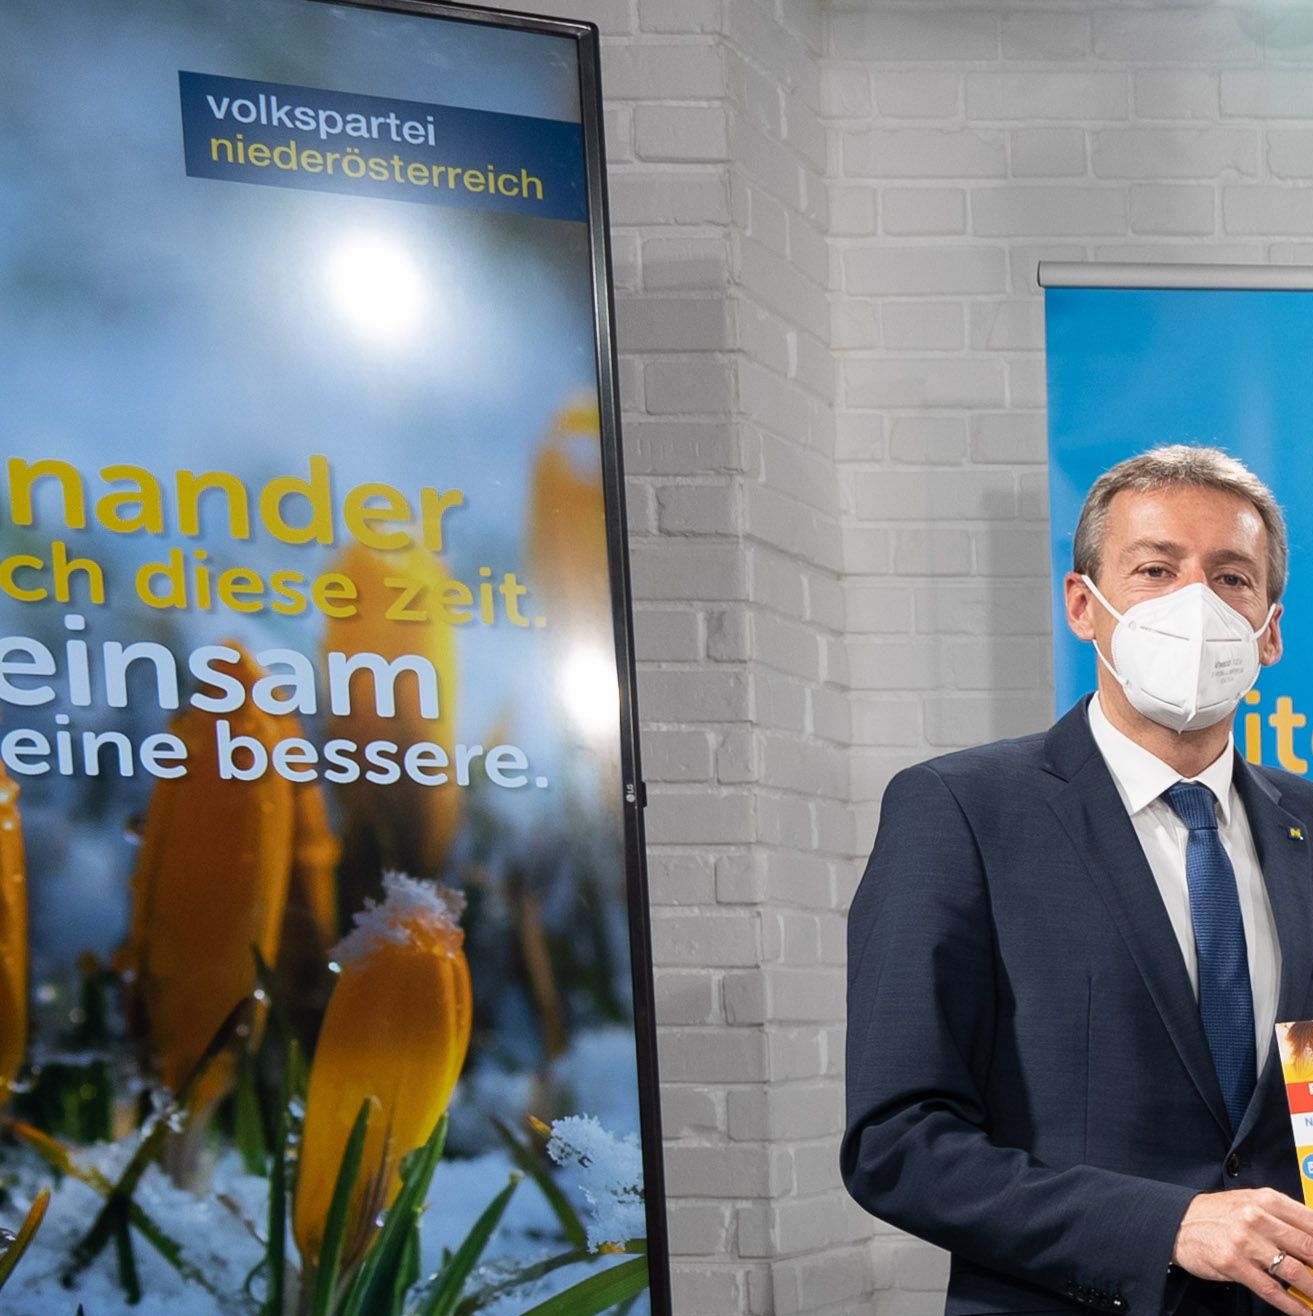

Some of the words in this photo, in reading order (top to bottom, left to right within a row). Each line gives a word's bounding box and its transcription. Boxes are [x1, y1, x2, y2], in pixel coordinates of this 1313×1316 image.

[206, 93, 436, 147] volkspartei
[209, 134, 544, 199] niederösterreich
[7, 455, 464, 551] nander
[134, 547, 358, 618] diese
[384, 566, 547, 628] zeit.
[0, 614, 439, 719] einsam
[1, 713, 188, 778] eine
[215, 719, 548, 788] bessere.
